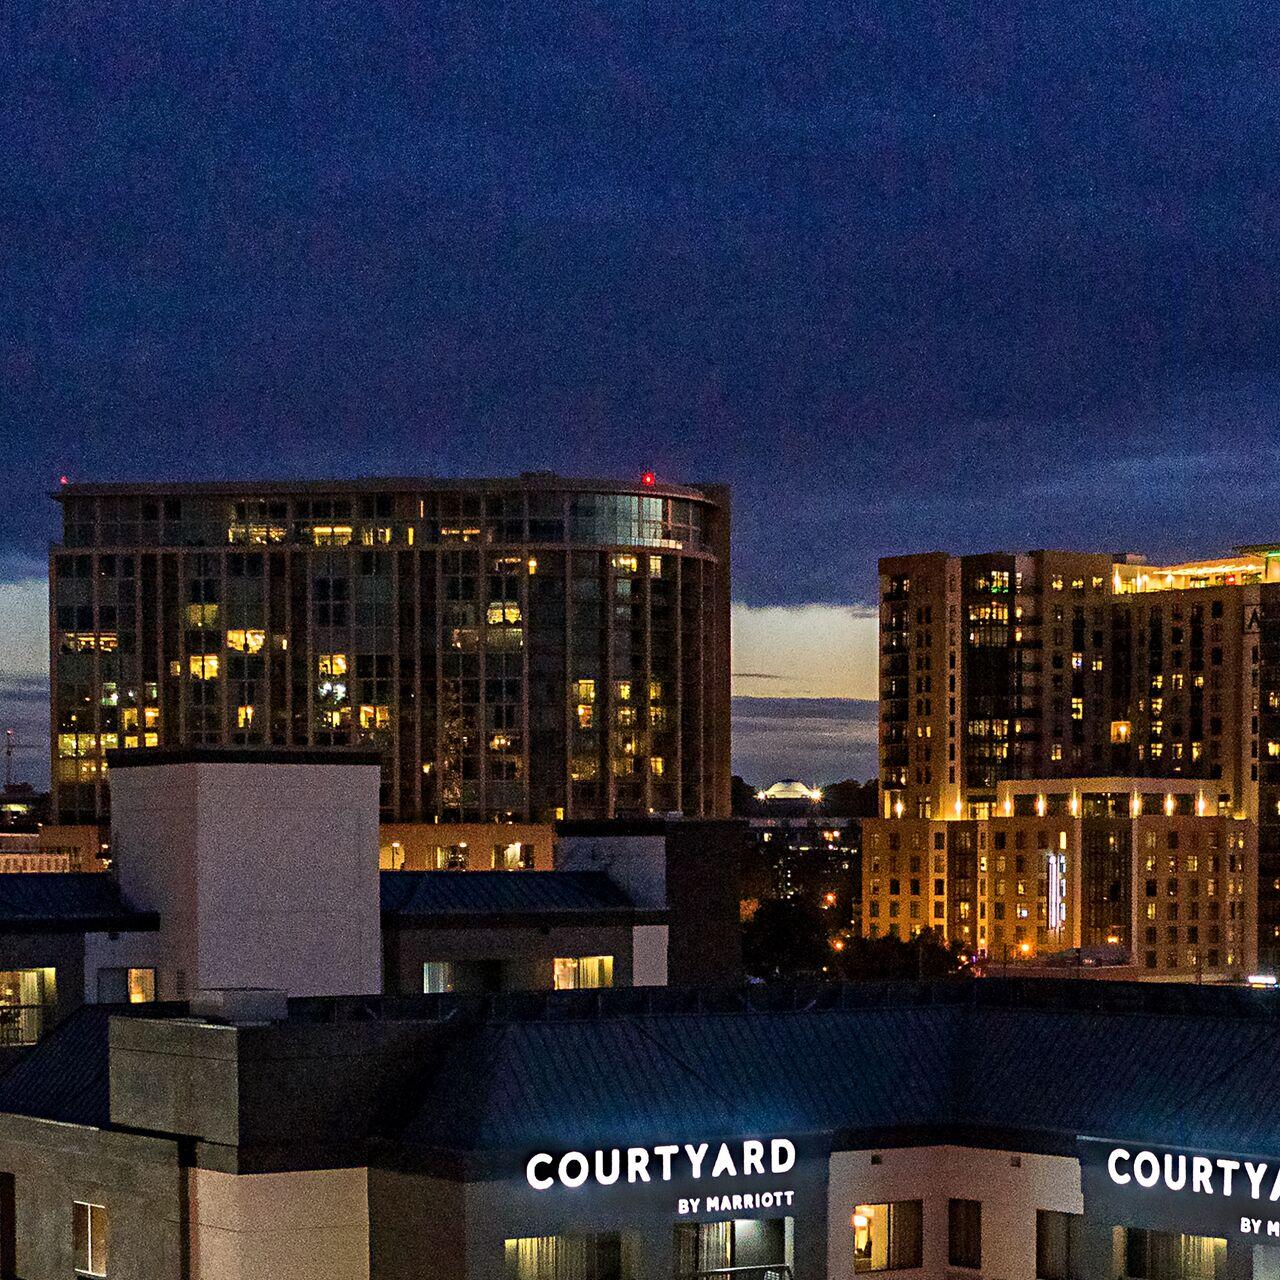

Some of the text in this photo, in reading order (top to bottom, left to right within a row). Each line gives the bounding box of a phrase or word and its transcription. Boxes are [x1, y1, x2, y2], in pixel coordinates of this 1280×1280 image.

[526, 1138, 797, 1191] COURTYARD
[678, 1190, 795, 1215] BY MARRIOTT
[1240, 1216, 1263, 1235] BY
